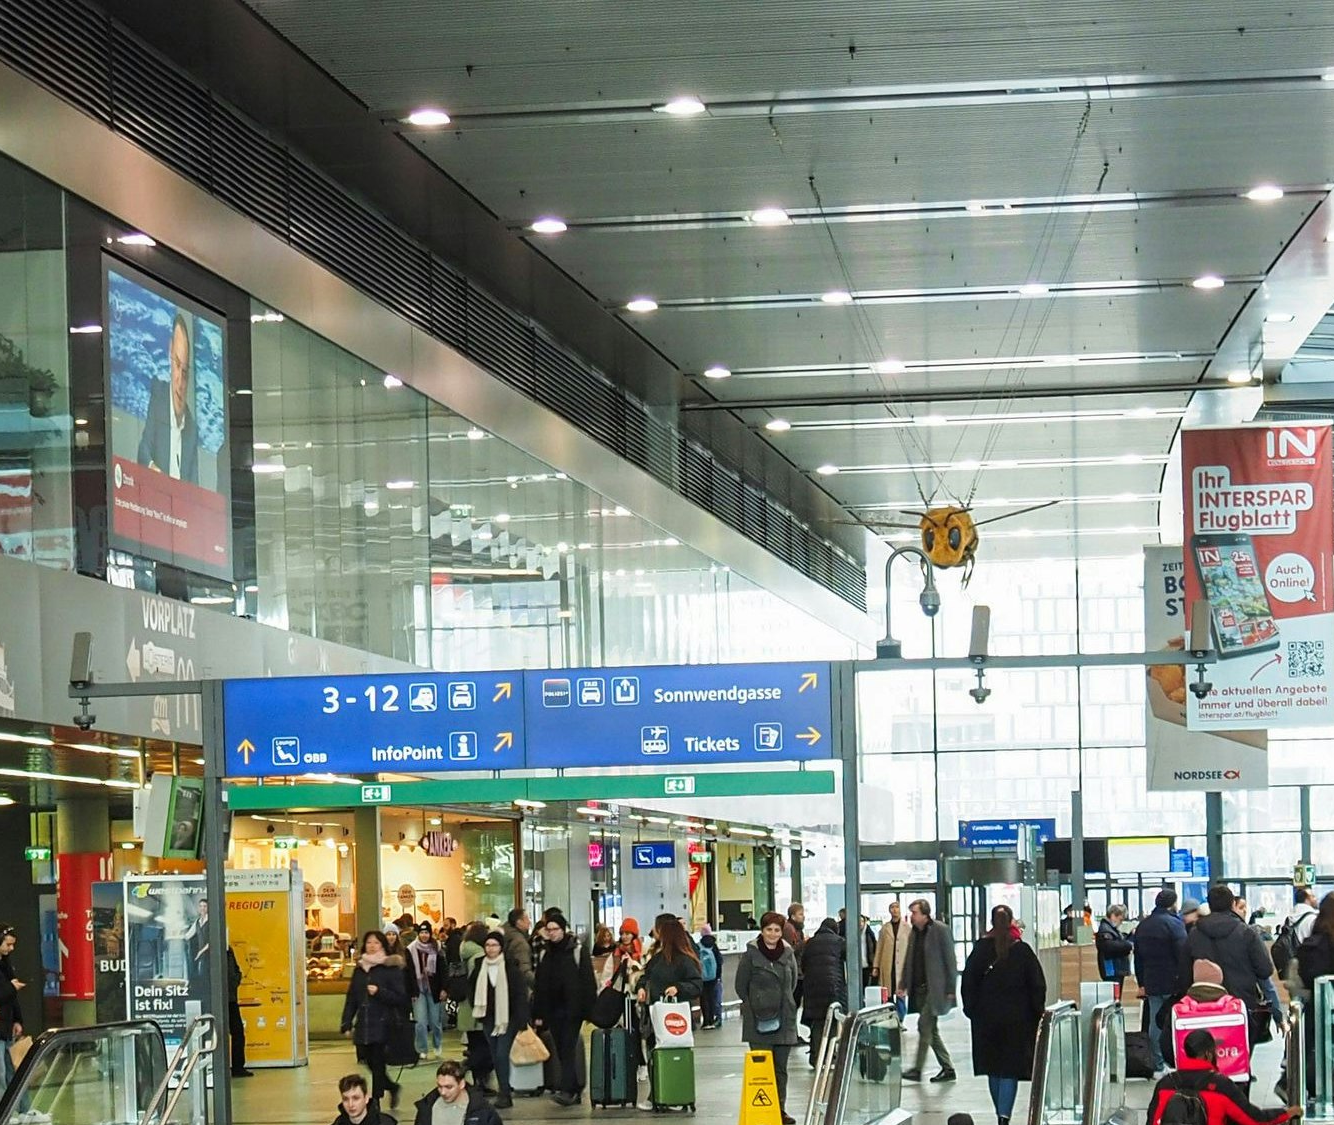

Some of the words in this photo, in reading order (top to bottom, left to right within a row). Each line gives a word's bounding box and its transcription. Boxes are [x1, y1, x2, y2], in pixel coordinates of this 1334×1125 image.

[1266, 429, 1316, 459] IN
[1198, 471, 1225, 489] Ihr
[1199, 489, 1307, 509] INTERSPAR
[1199, 510, 1291, 532] Flugblatt
[1275, 564, 1304, 575] Auch
[1270, 578, 1310, 589] Online!
[142, 596, 196, 640] VORPLATZ
[653, 685, 782, 705] Sonnwendgasse
[1221, 685, 1272, 697] aktuellen
[1275, 684, 1328, 697] Angebote
[322, 686, 340, 714] 3
[364, 685, 400, 712] 12
[1198, 700, 1231, 710] immer
[1235, 699, 1254, 709] und
[1257, 698, 1293, 708] überall
[1296, 697, 1329, 707] dabei!
[683, 735, 740, 753] Tickets
[371, 745, 444, 762] InfoPoint
[1173, 770, 1223, 781] NORDSEE
[228, 900, 276, 911] REGIOJET
[134, 985, 163, 997] Dein
[165, 985, 189, 997] Sitz
[134, 999, 152, 1011] ist
[153, 998, 174, 1010] fix!
